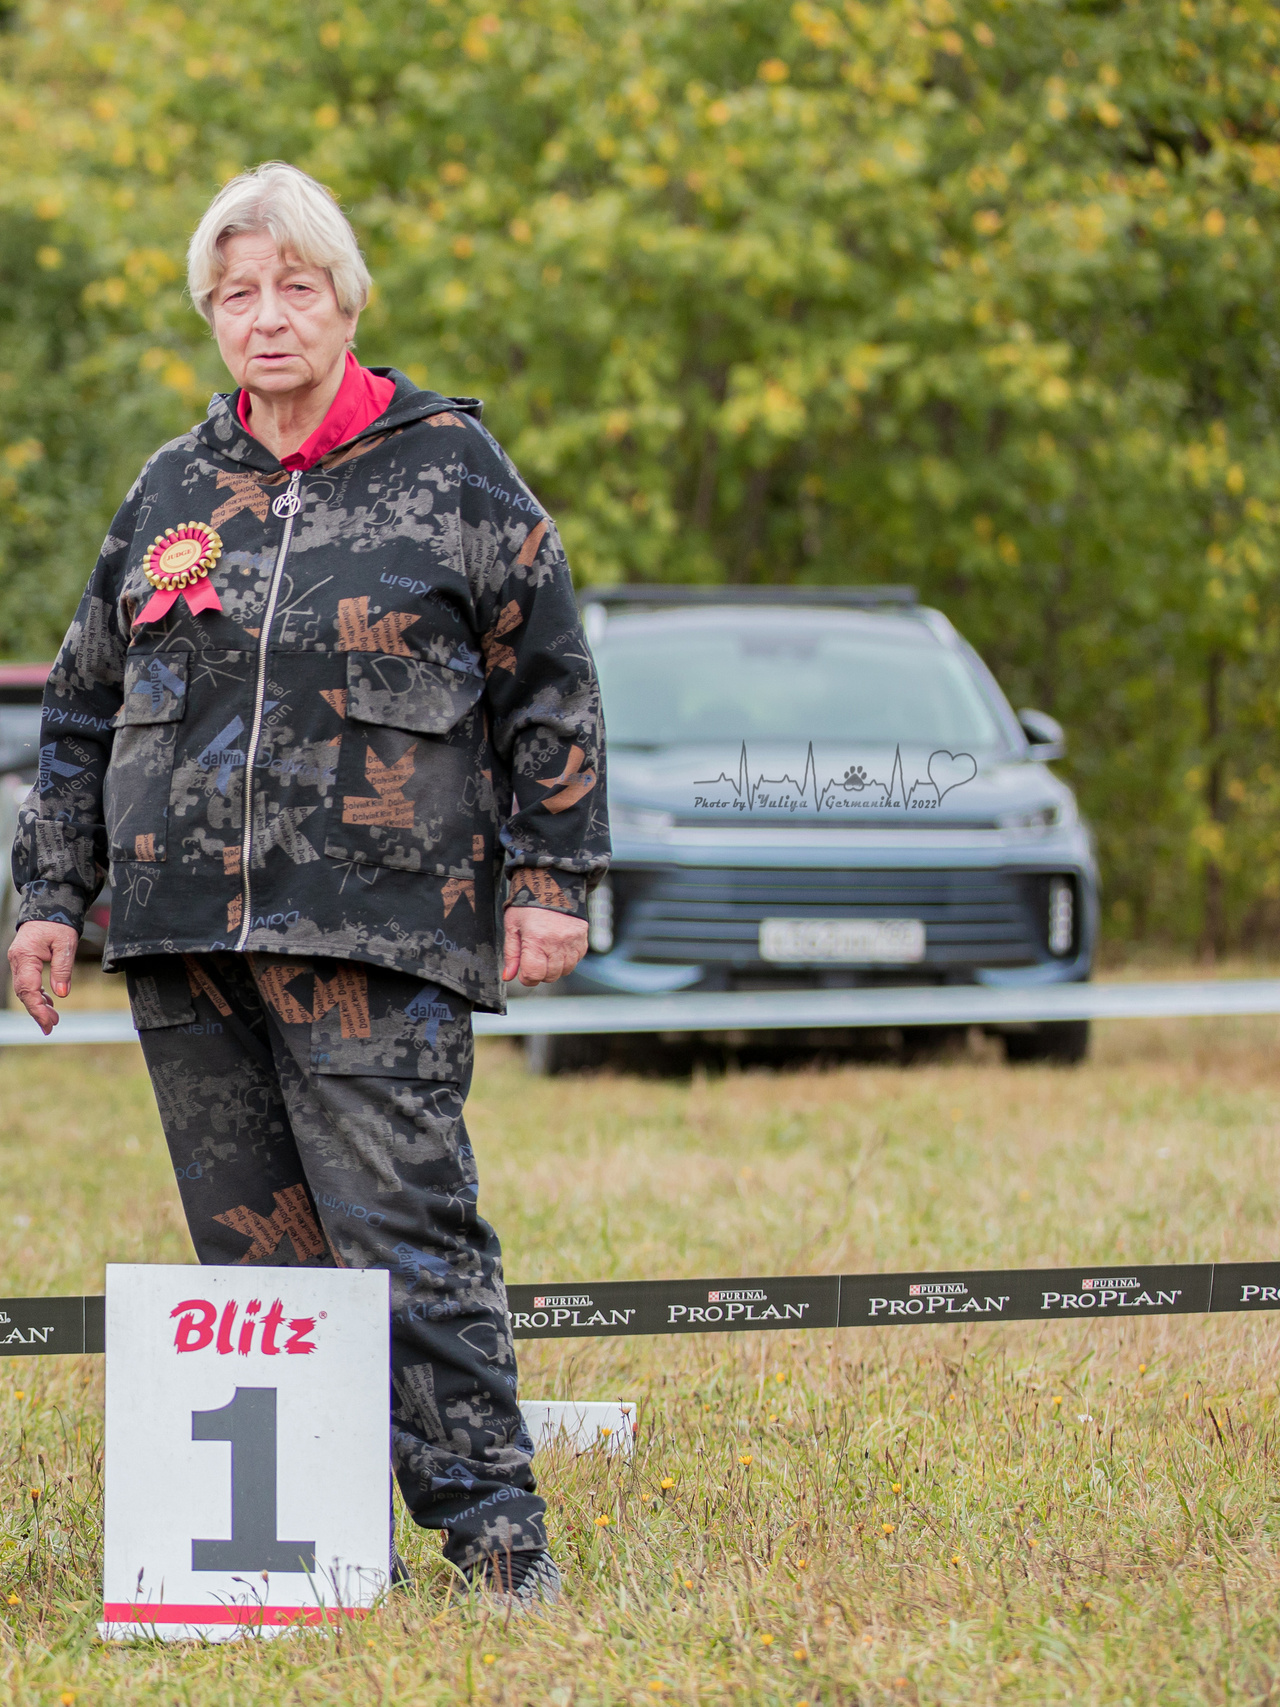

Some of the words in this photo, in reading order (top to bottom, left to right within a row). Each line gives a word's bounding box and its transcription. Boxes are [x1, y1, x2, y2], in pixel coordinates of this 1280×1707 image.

[457, 462, 510, 503] Dalvin
[166, 549, 192, 561] JUDGE
[379, 571, 432, 597] Klein
[151, 663, 162, 703] dalvin
[63, 736, 98, 767] jeans
[202, 750, 241, 766] dalvin
[40, 749, 54, 788] dalvin
[56, 771, 98, 798] klein
[251, 910, 300, 928] Dalvi
[410, 1003, 448, 1018] dalvin
[322, 1194, 387, 1228] Dalvin
[920, 1284, 963, 1294] PURINA
[1094, 1279, 1136, 1289] PURINA
[545, 1297, 589, 1307] PURINA
[718, 1290, 763, 1301] PURINA
[191, 1386, 316, 1573] 1
